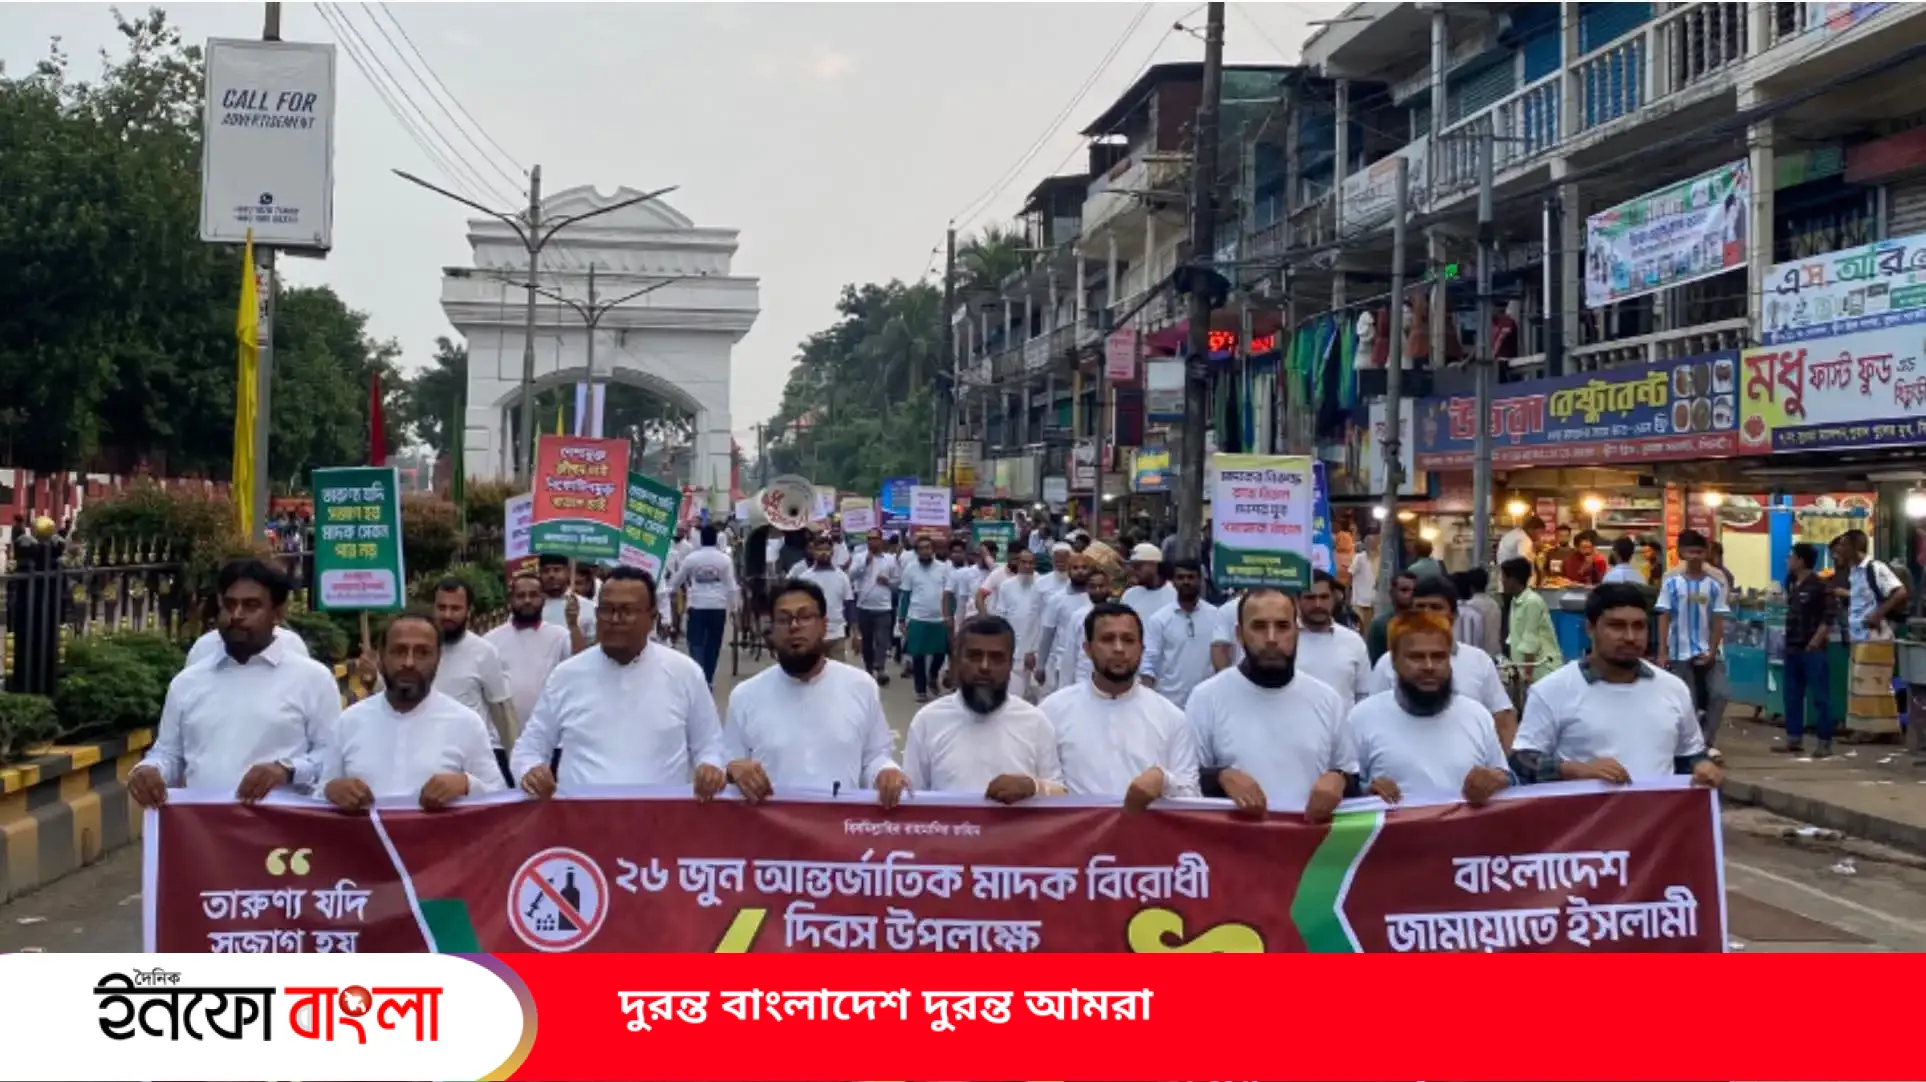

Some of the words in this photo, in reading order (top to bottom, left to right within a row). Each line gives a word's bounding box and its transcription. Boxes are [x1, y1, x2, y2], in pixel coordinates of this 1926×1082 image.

[220, 112, 317, 129] ADVERTISEMENT
[222, 88, 269, 111] CALL
[276, 91, 318, 113] FOR
[1744, 348, 1808, 420] মধু
[616, 857, 669, 893] ২৬
[677, 858, 747, 907] জুন
[753, 848, 965, 899] আন্তর্জাতিক
[970, 864, 1079, 900] মাদক
[1086, 851, 1210, 902] বিরোধী
[1451, 850, 1630, 893] বাংলাদেশ
[200, 886, 308, 921] তারুণ্য
[312, 878, 374, 922] যদি
[1384, 907, 1560, 953] জামায়াতে
[1566, 885, 1698, 946] ইসলামী
[784, 900, 879, 949] দিবস
[884, 906, 1043, 953] উপলক্ষে
